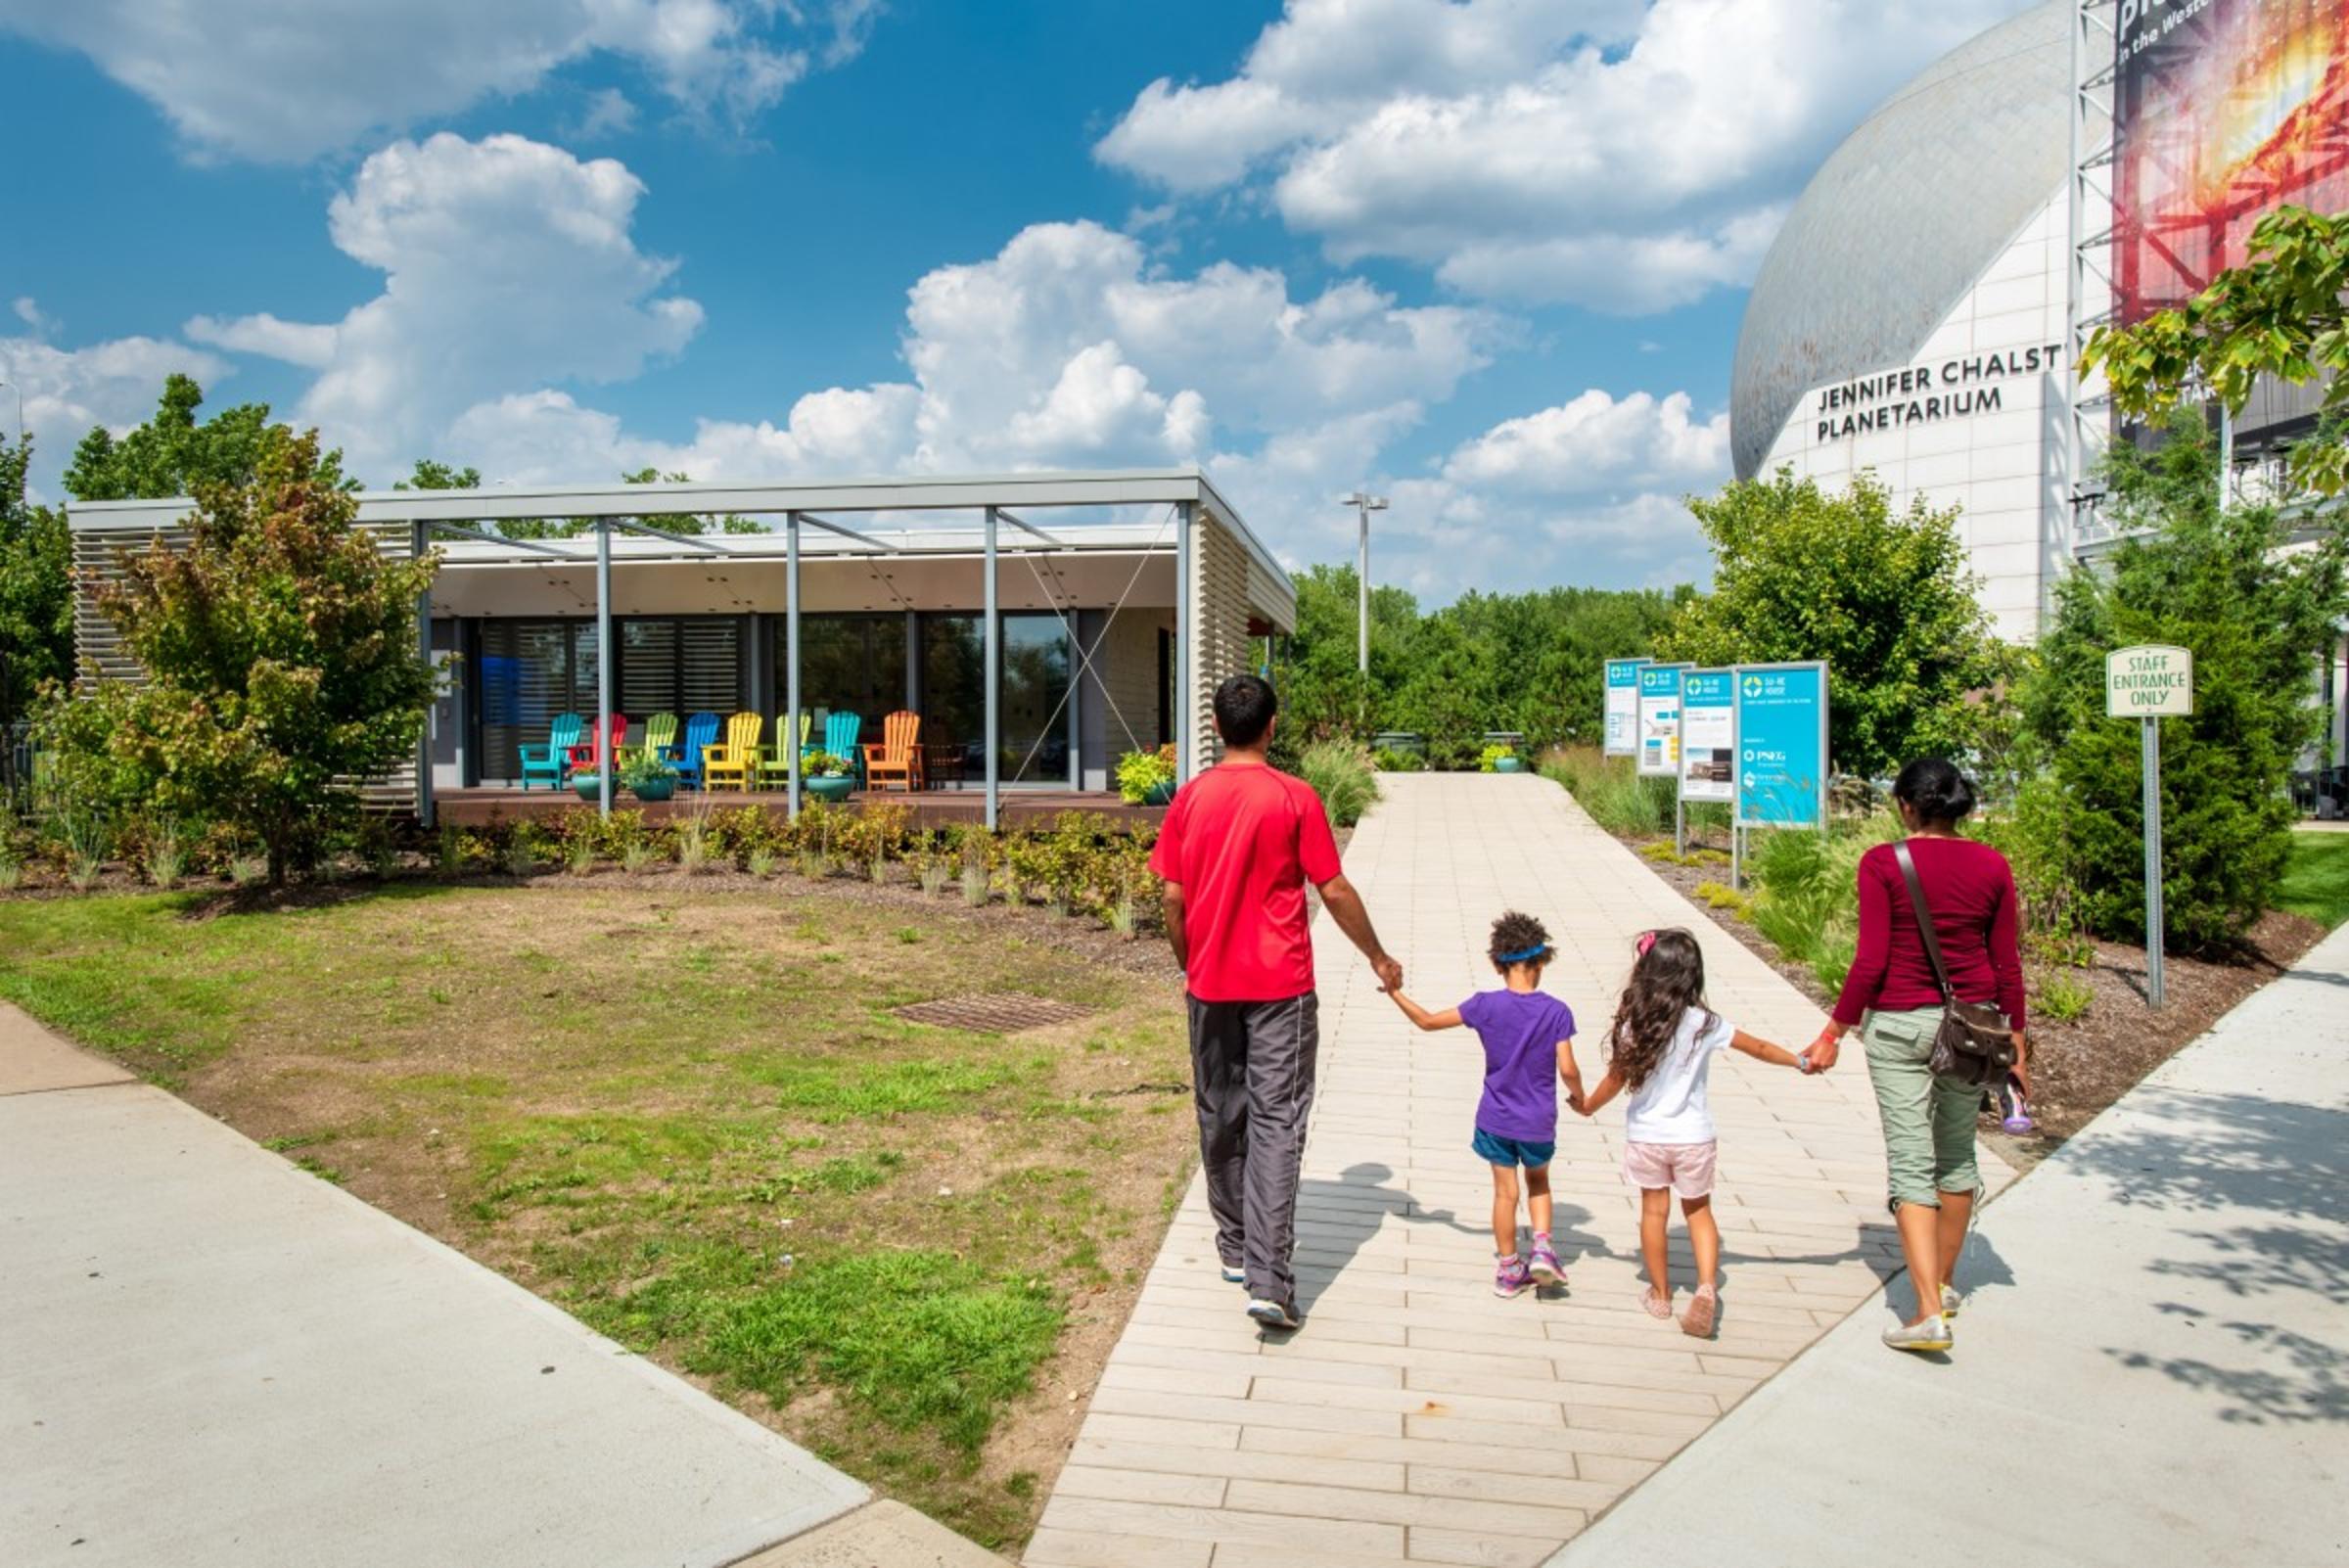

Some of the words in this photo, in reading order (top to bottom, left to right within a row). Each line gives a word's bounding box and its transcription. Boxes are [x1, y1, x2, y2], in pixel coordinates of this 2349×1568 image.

[2133, 28, 2158, 54] the
[1819, 367, 1931, 412] JENNIFER
[1941, 343, 2068, 385] CHALST
[1818, 387, 2002, 440] PLANETARIUM
[2129, 655, 2169, 672] STAFF
[2113, 671, 2186, 689] ENTRANCE
[2131, 690, 2170, 705] ONLY
